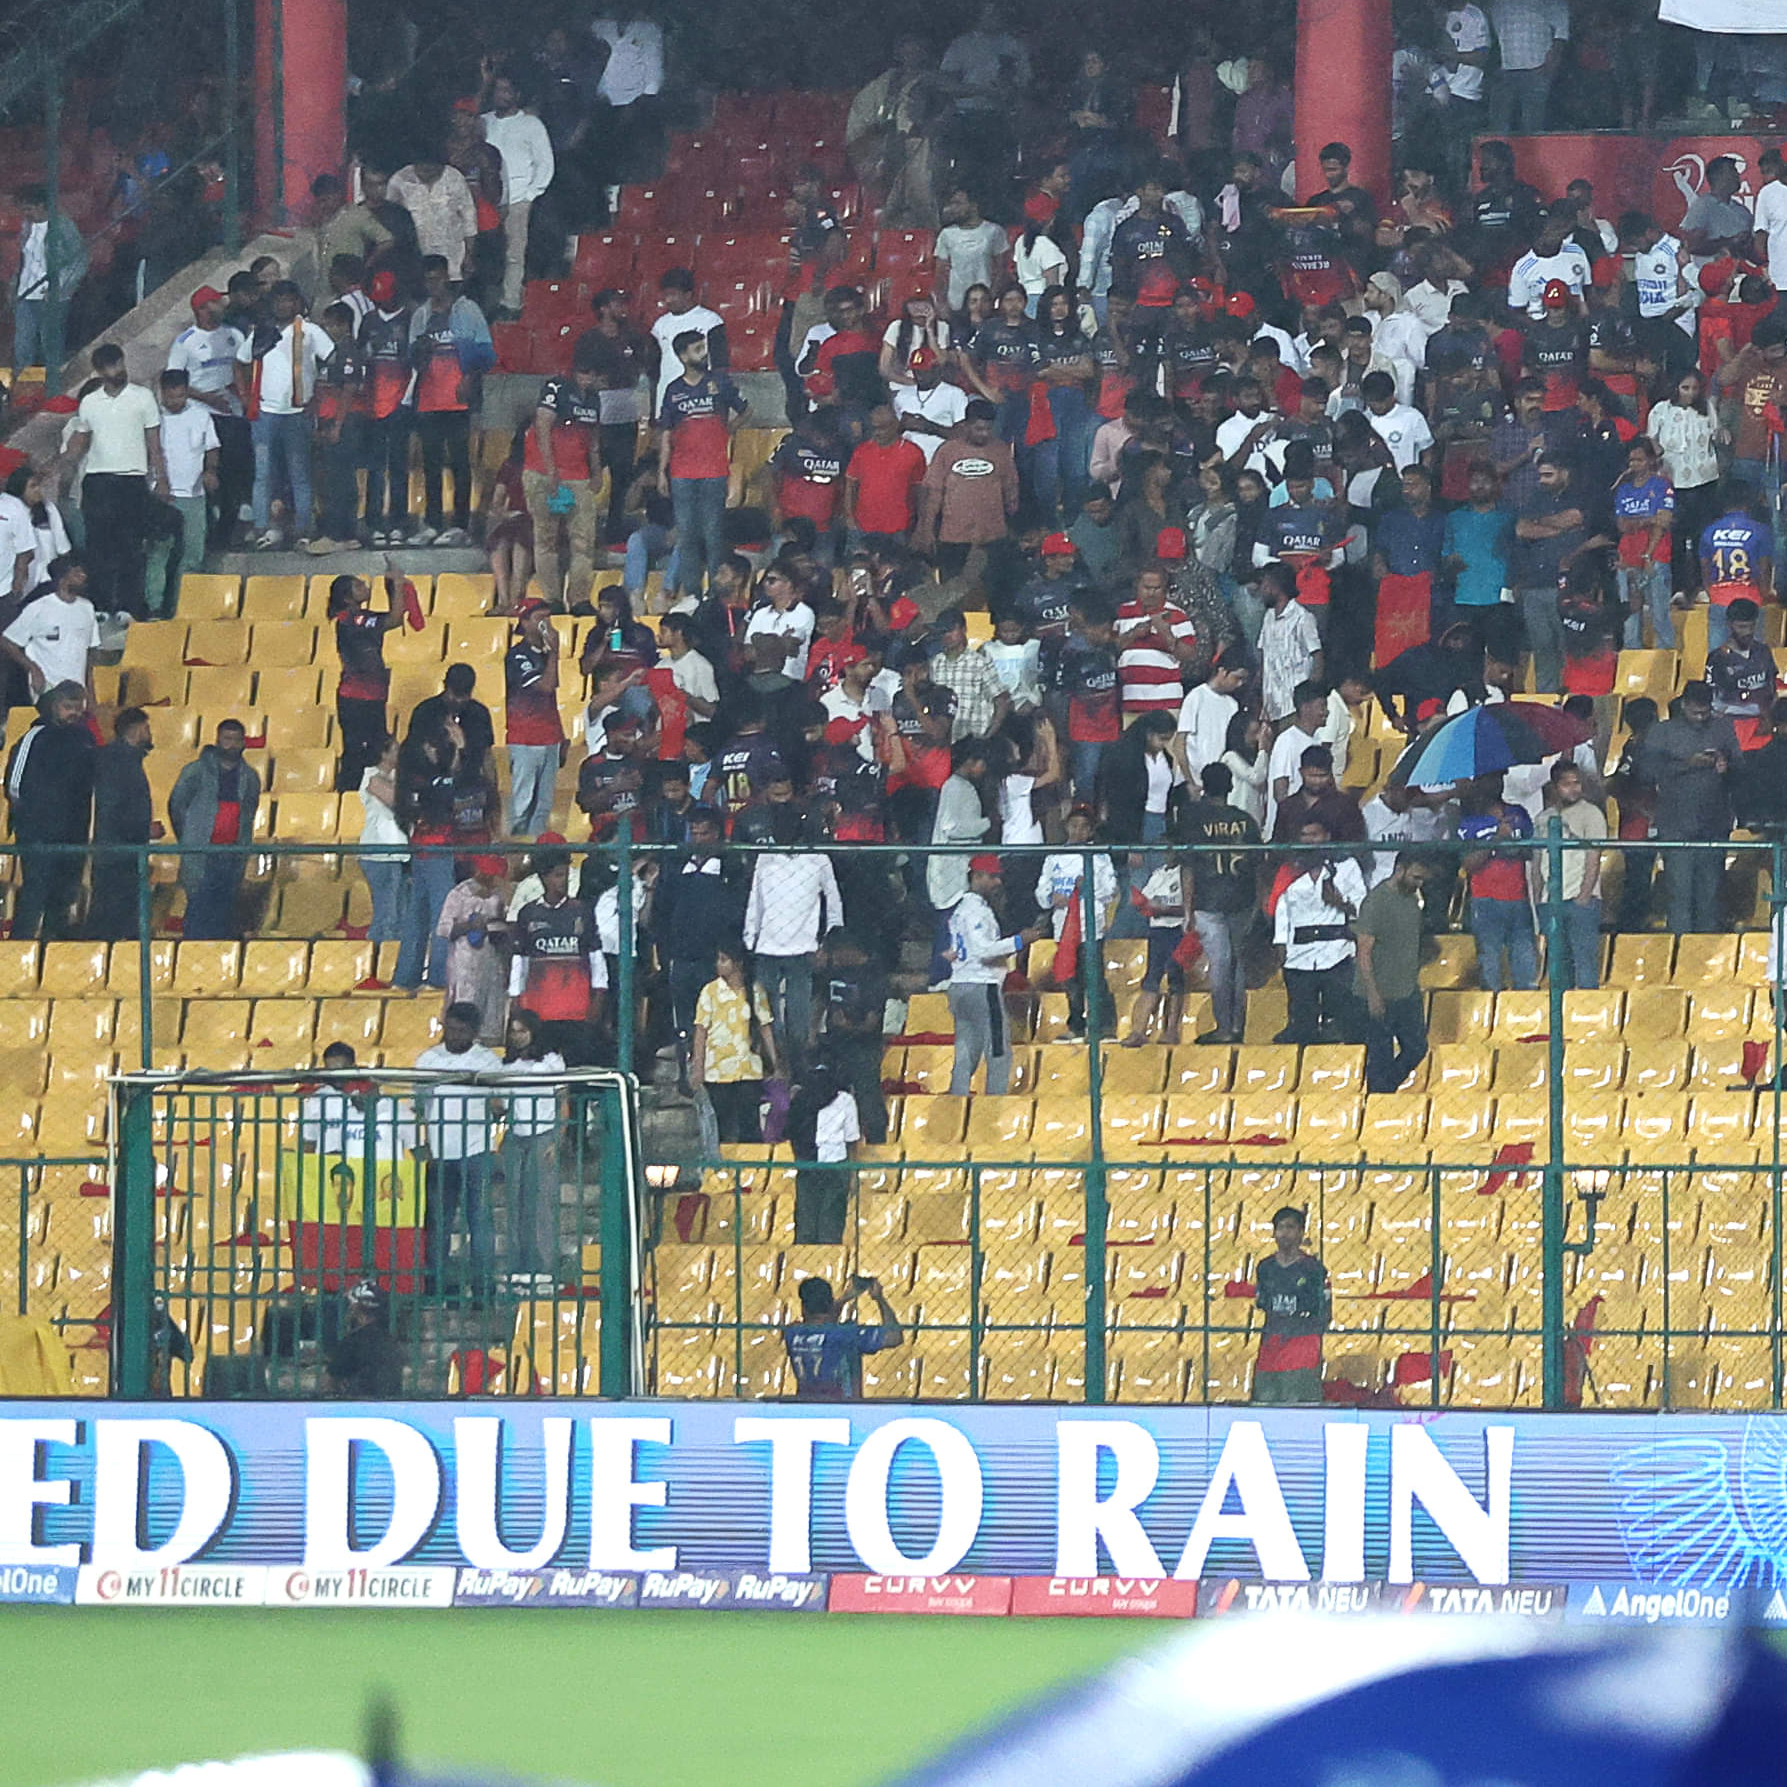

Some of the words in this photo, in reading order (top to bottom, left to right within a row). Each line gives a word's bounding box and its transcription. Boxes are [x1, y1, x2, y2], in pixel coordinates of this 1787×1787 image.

[678, 397, 712, 412] QATAR
[804, 458, 839, 470] QATAR
[1283, 535, 1320, 546] QATAR
[1713, 529, 1751, 541] KEI
[1713, 549, 1750, 581] 18
[723, 751, 749, 765] KEI
[1204, 821, 1248, 836] VIRAT
[535, 936, 578, 950] QATAR
[0, 1418, 232, 1566] ED
[306, 1418, 678, 1571] DUE
[736, 1418, 982, 1578] TO
[1055, 1420, 1514, 1585] RAIN
[456, 1569, 533, 1601] RuPay
[549, 1570, 627, 1602] RuPay
[641, 1573, 720, 1604] RuPay
[735, 1574, 814, 1605] RuPay
[865, 1576, 975, 1594] CURVV
[1049, 1579, 1159, 1596] CURVV
[1244, 1583, 1312, 1613] TATA
[1319, 1583, 1369, 1614] NEU
[1430, 1589, 1498, 1616] TATA
[1502, 1589, 1552, 1617] NEU
[1611, 1588, 1730, 1623] AngelOne
